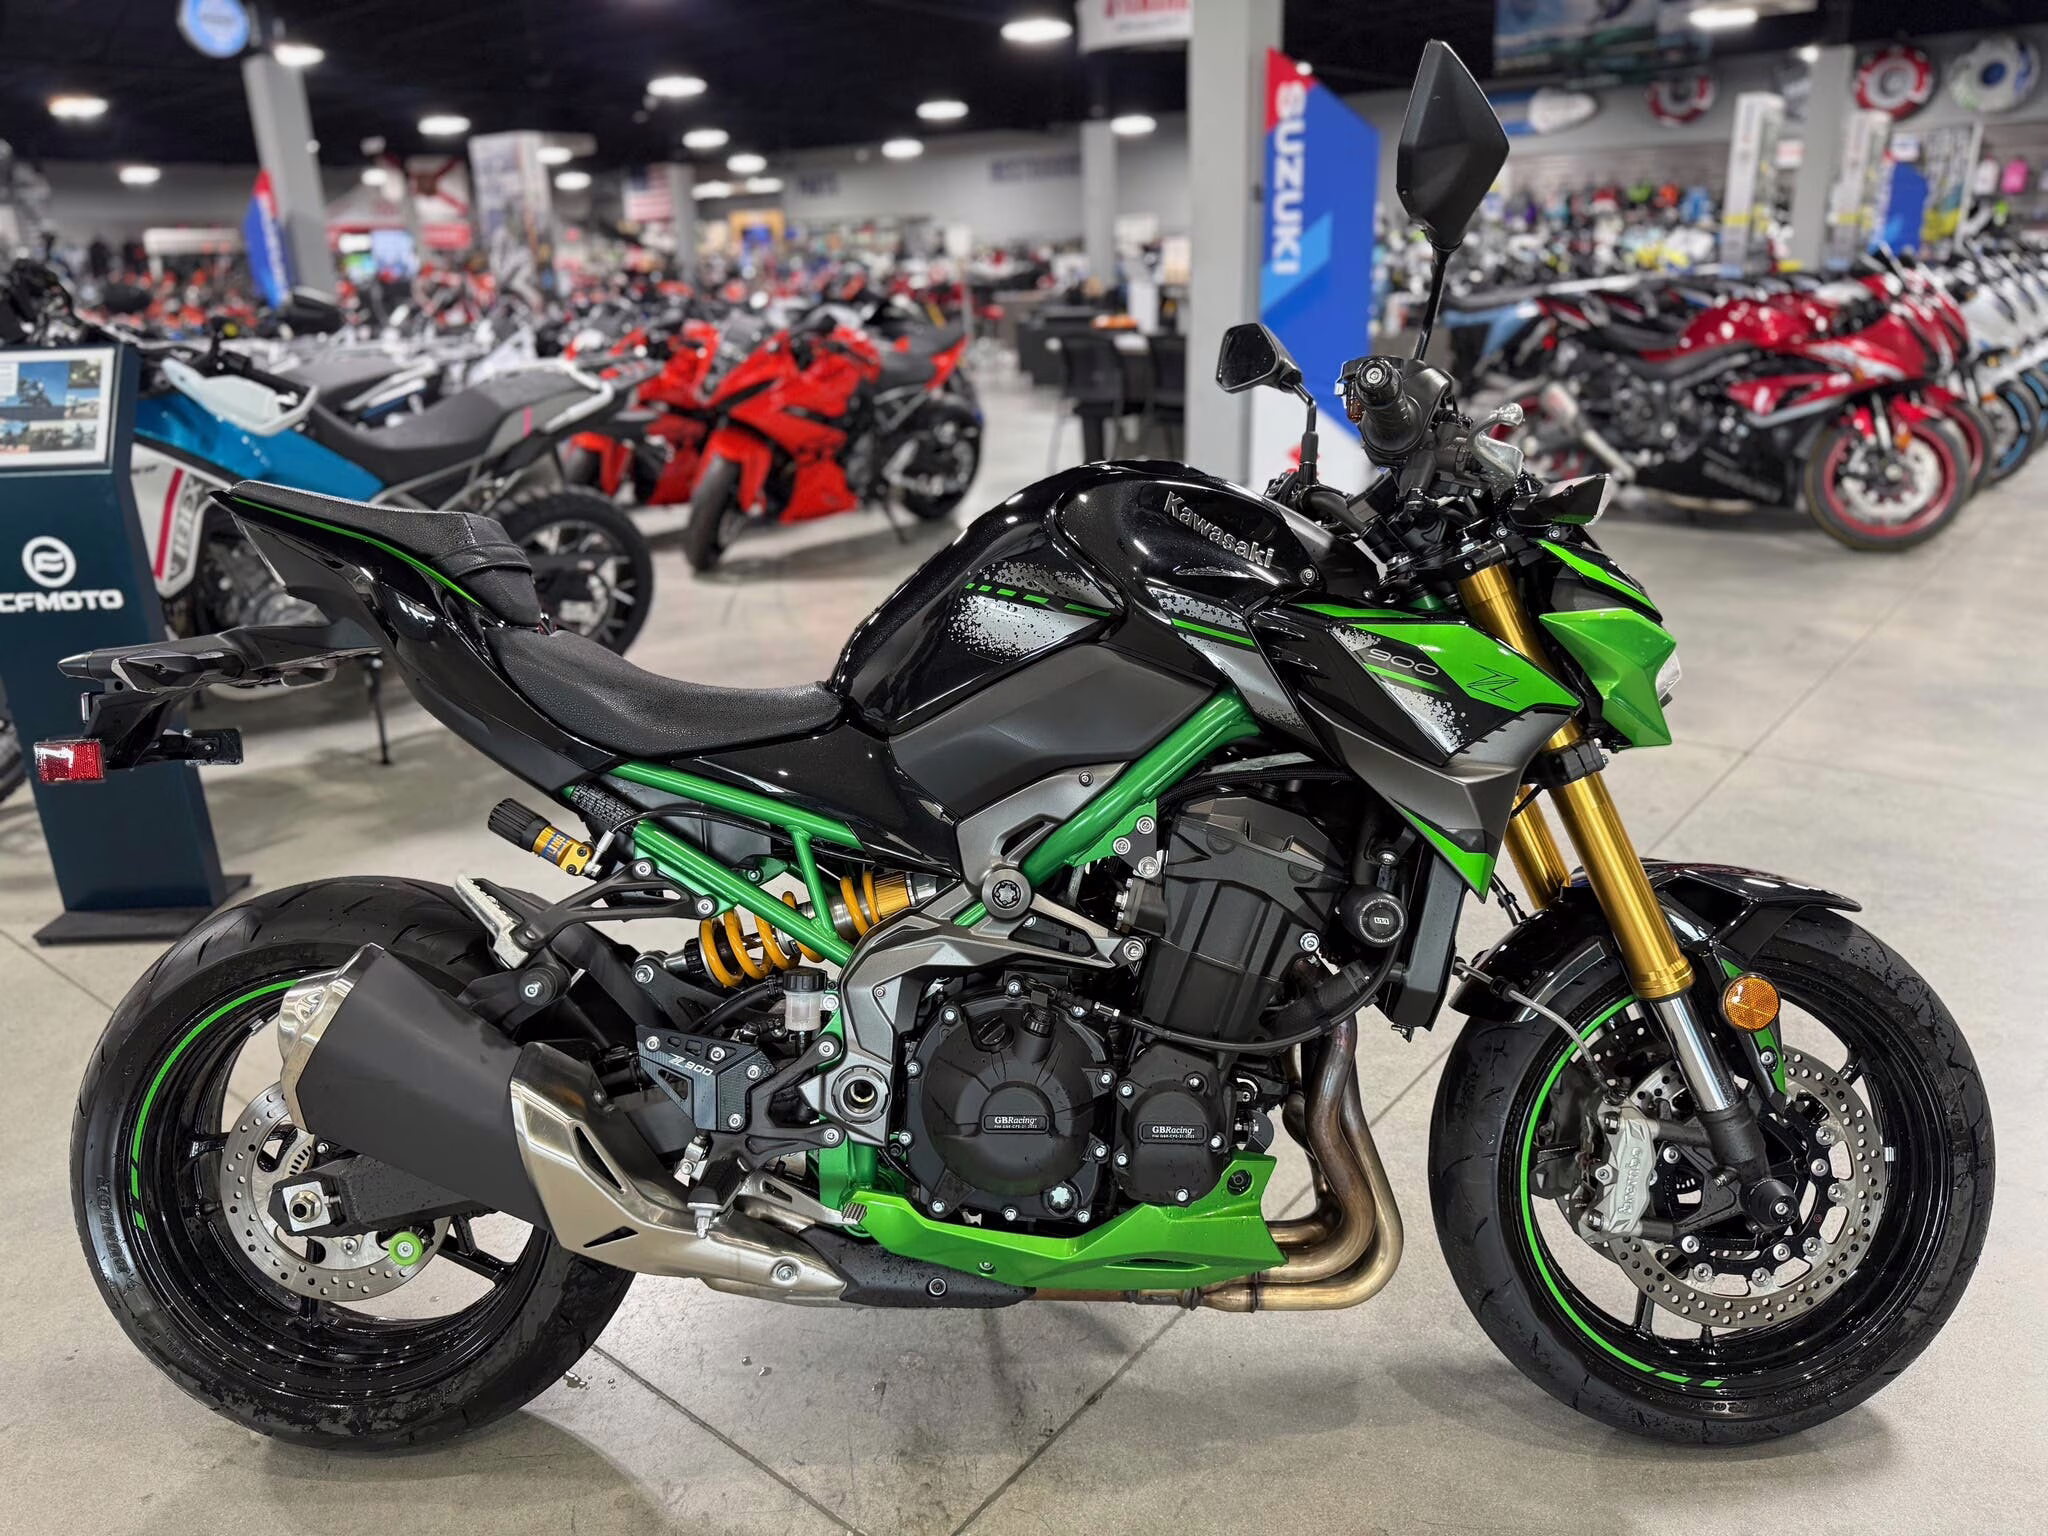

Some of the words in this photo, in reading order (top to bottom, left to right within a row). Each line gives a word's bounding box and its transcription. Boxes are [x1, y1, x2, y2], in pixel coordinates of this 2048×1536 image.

[1272, 80, 1307, 275] SUZUKI
[1164, 490, 1274, 568] Kawasaki
[0, 589, 124, 613] CFMOTO
[1368, 648, 1439, 676] 900
[994, 1116, 1037, 1126] GBRacing
[1152, 1126, 1194, 1135] GBRacing
[1618, 1147, 1641, 1214] brembo
